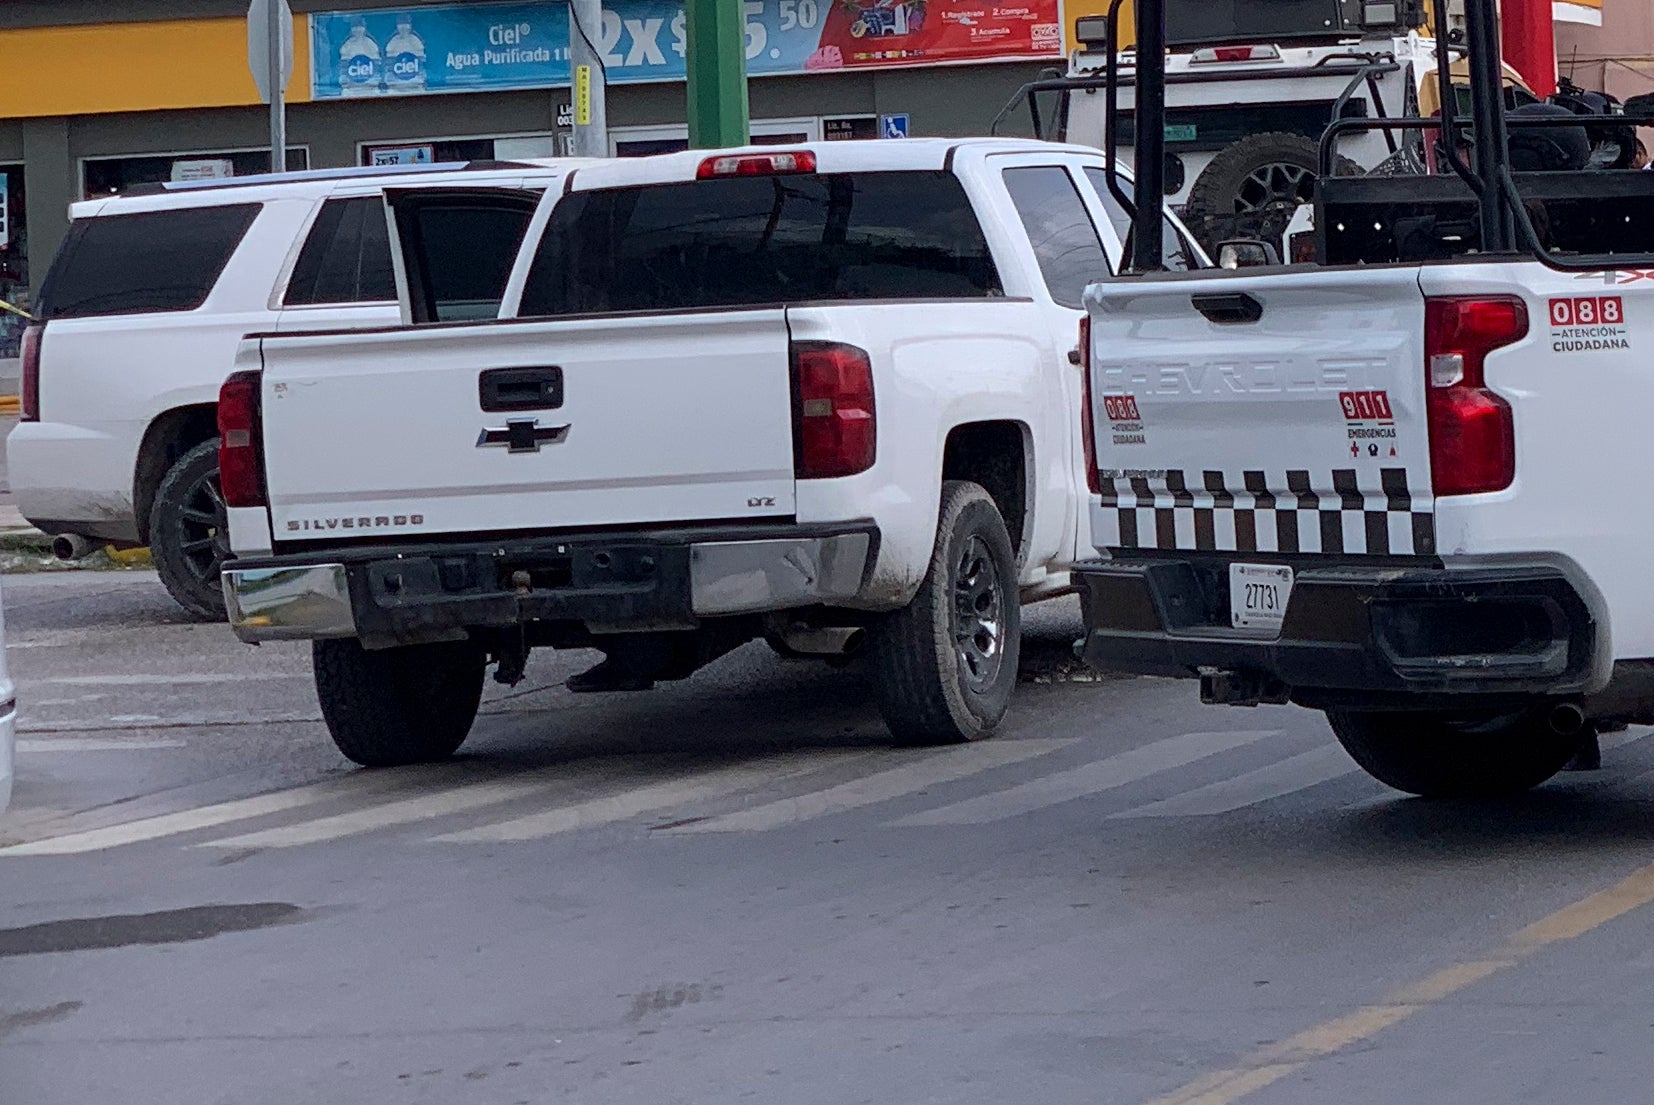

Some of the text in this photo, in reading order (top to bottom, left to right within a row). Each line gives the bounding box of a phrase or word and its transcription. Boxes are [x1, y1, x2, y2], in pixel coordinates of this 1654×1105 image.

[393, 57, 419, 74] ciel
[445, 52, 480, 71] Agua
[484, 47, 550, 66] Purificada
[347, 60, 374, 77] ciel
[1551, 298, 1620, 324] 088
[1561, 326, 1617, 338] ATENCIÓN
[1553, 339, 1630, 352] CIUDADANA
[1105, 398, 1138, 418] 088
[1342, 394, 1388, 417] 911
[1347, 427, 1396, 439] EMERGENCIAS
[287, 514, 424, 531] SILVERADO
[1245, 583, 1280, 610] 27731
